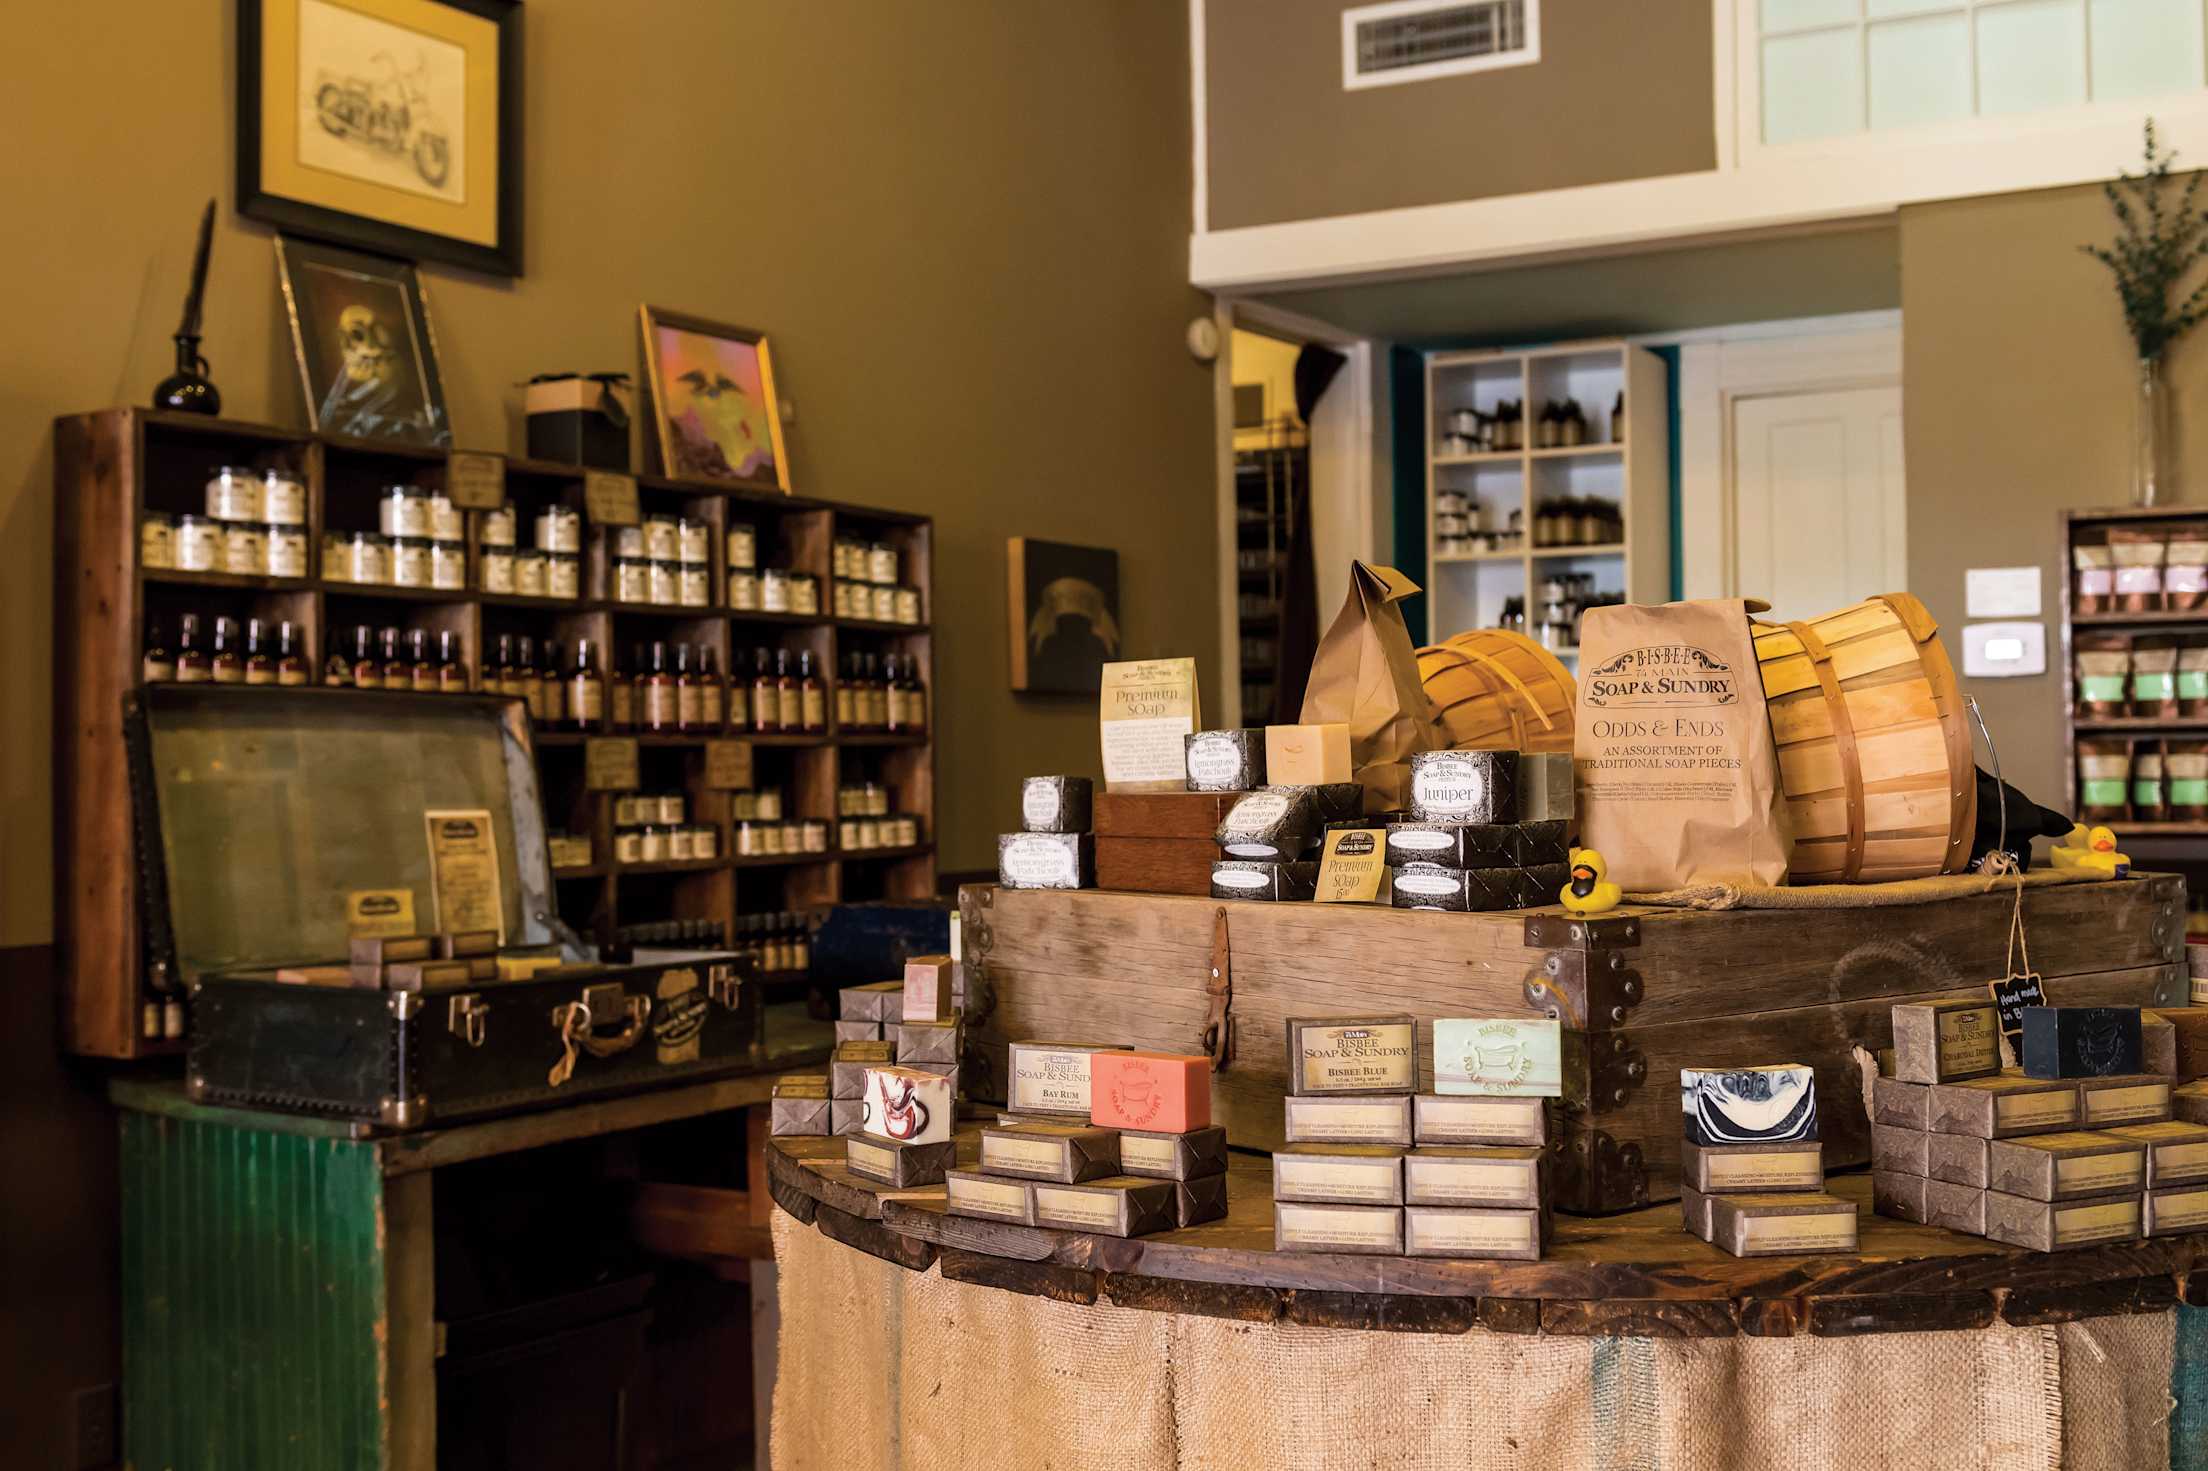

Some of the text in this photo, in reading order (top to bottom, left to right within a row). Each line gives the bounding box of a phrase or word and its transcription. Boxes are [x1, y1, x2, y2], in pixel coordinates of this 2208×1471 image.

[1592, 677, 1730, 697] SOAP & SUNDRY
[1116, 688, 1179, 705] Premium
[1592, 718, 1724, 738] ODDS & ENDS
[1603, 745, 1723, 756] AN ASSORTMENT OF
[1583, 758, 1742, 769] TRADITIONAL SOAP PIECES
[1424, 786, 1474, 803] Juniper
[1328, 859, 1374, 873] Premium
[2000, 991, 2021, 1006] Hand
[2003, 1008, 2013, 1021] in
[1478, 1025, 1518, 1038] BISBEE
[1337, 1038, 1379, 1048] BISBEE
[1304, 1047, 1409, 1059] SOAP & SUNDRY
[1044, 1062, 1080, 1073] BISBEE
[1328, 1067, 1388, 1077] BISBEE BLUE
[1016, 1069, 1091, 1082] SOAP & SUND
[1463, 1056, 1481, 1084] SOAP
[1496, 1057, 1534, 1094] SUNDRY
[1043, 1089, 1079, 1099] BAY RUM
